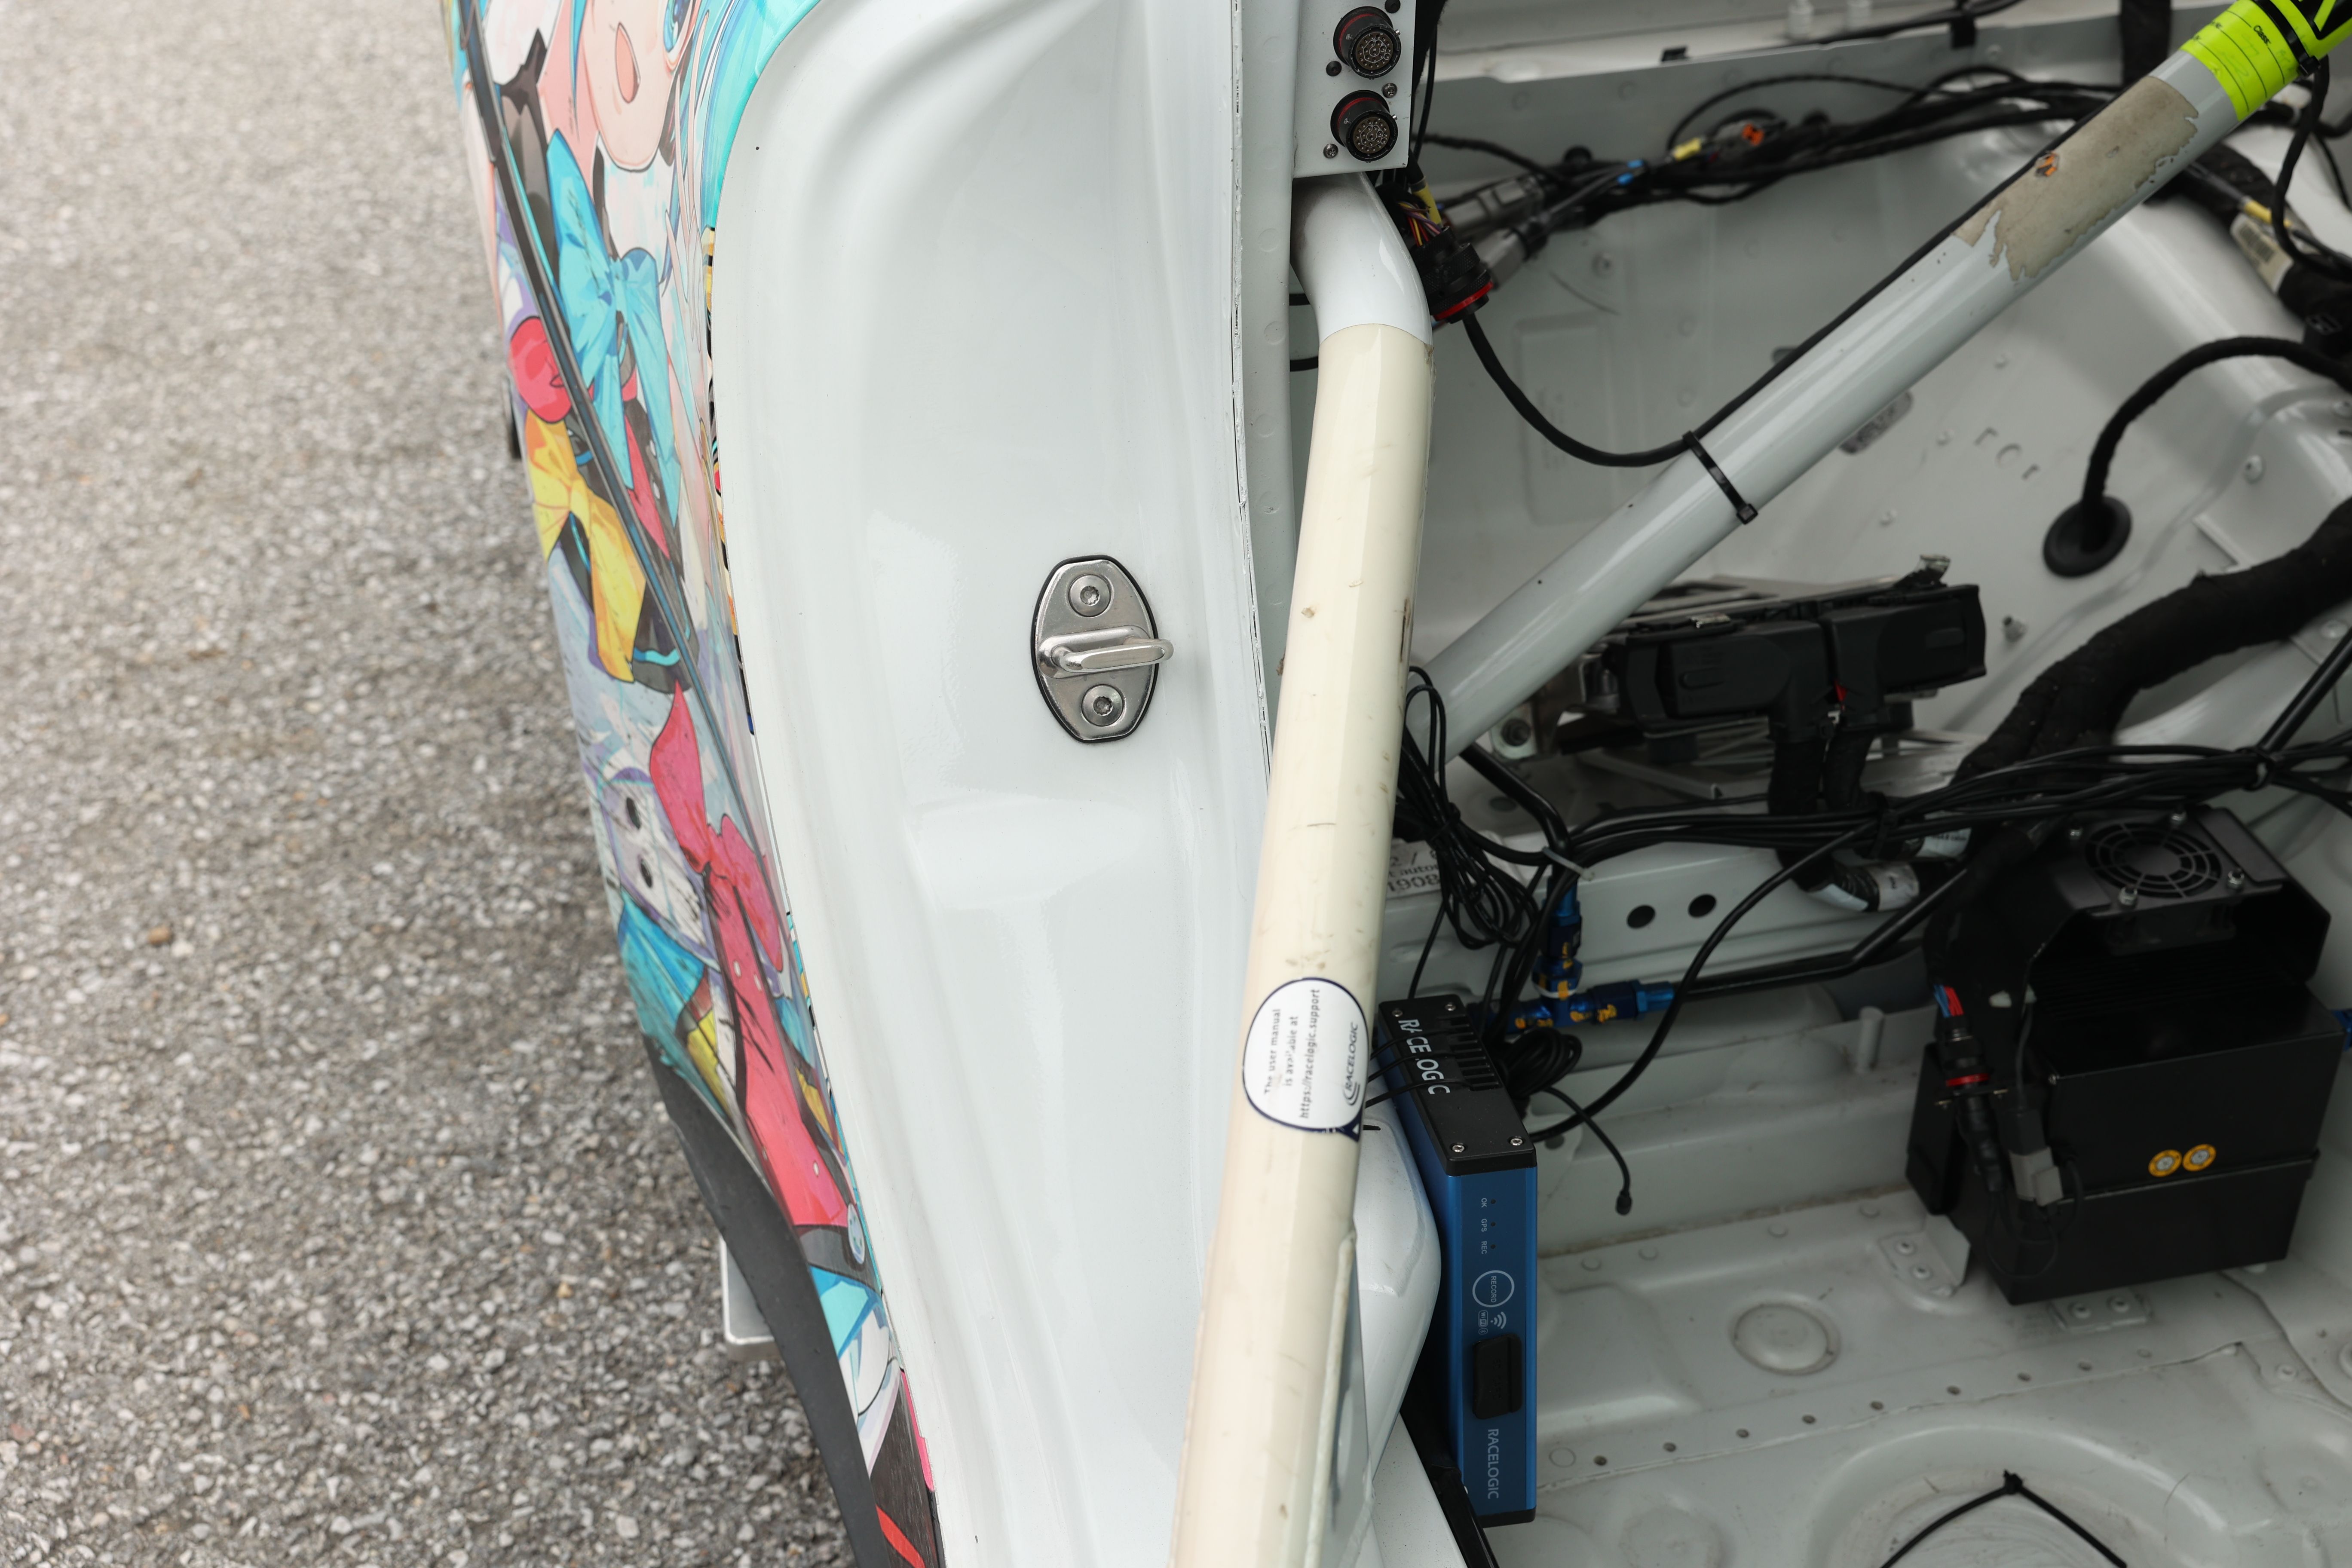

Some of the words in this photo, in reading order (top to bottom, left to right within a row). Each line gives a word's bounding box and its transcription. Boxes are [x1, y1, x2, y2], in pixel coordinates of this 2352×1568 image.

[1269, 1050, 1277, 1072] user
[1271, 1008, 1281, 1046] manual
[1283, 1078, 1292, 1087] is
[1289, 1016, 1298, 1027] at
[1298, 989, 1321, 1119] https://racelogic.support
[1344, 1021, 1359, 1091] RACELOGIC
[1398, 1019, 1451, 1095] RCEOGC
[1481, 1198, 1487, 1208] OK
[1487, 1428, 1499, 1500] RACELOGIC
